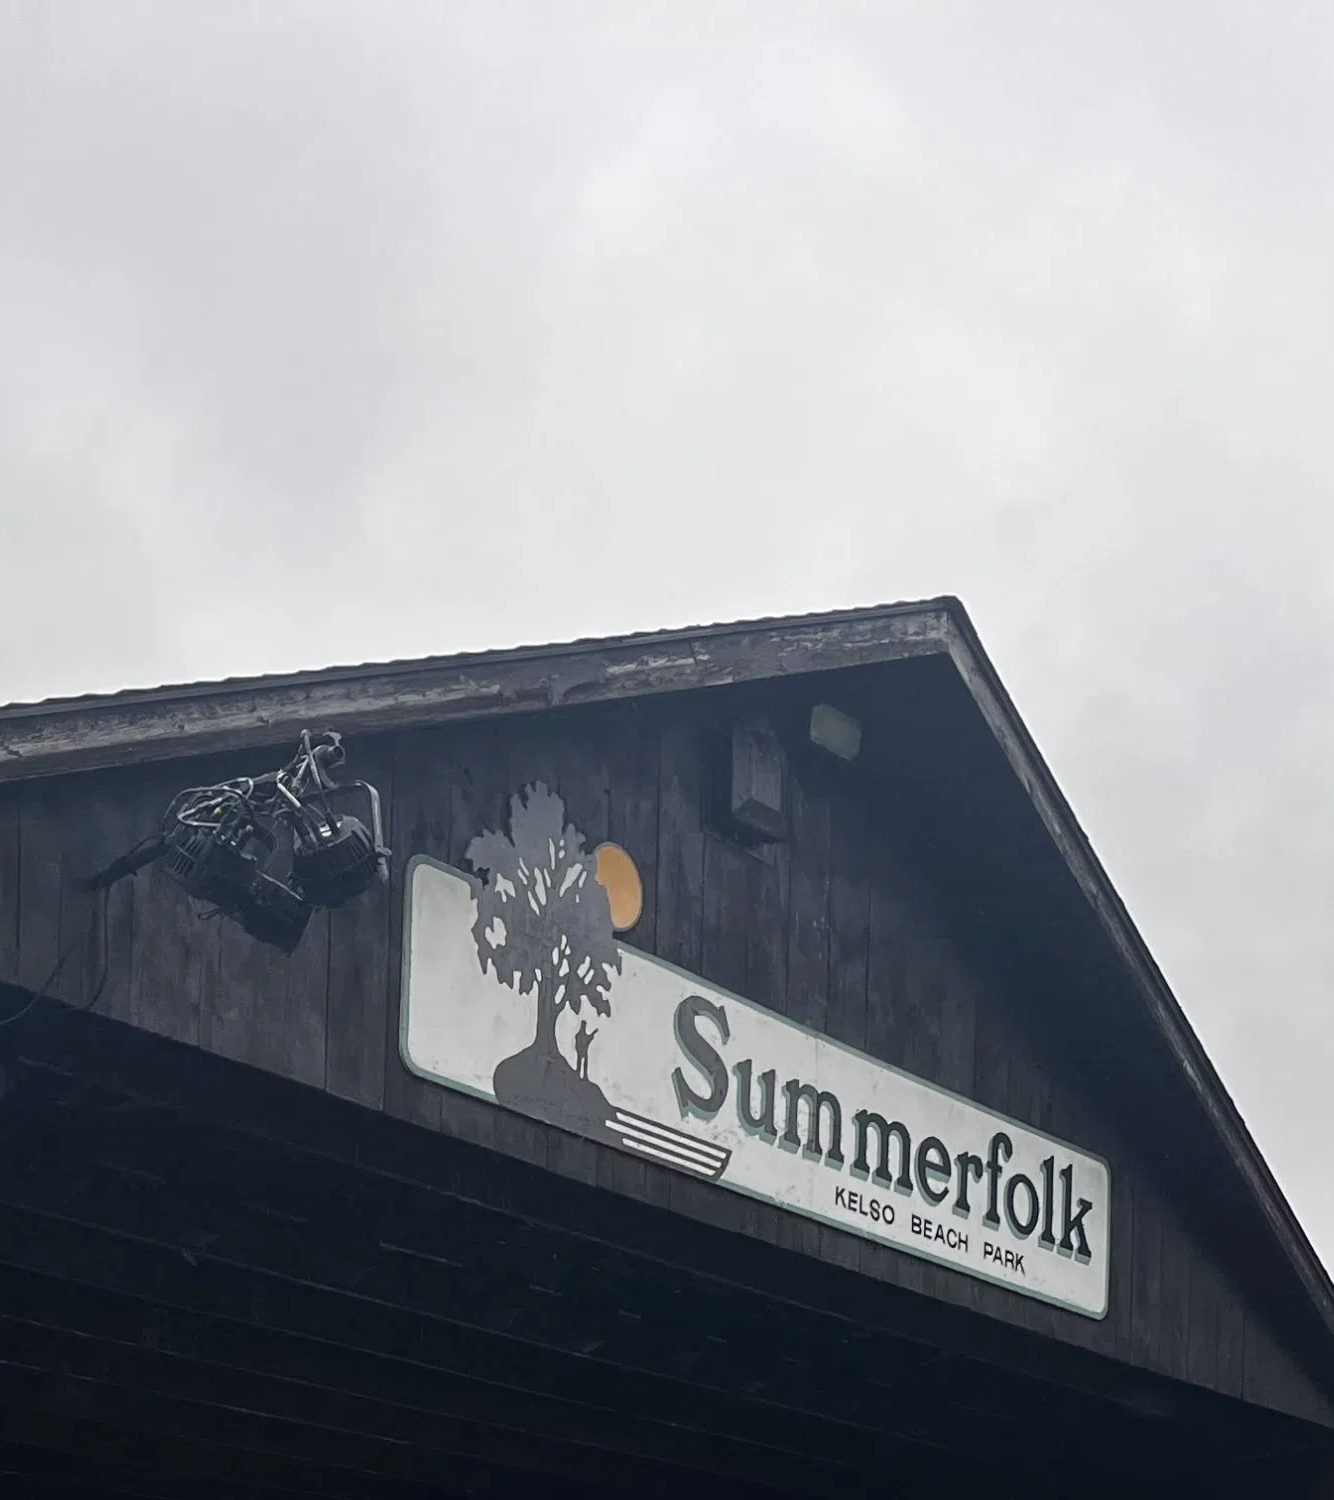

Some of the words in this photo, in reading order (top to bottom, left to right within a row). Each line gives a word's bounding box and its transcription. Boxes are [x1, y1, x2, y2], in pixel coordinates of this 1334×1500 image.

[672, 996, 1092, 1265] Summerfolk
[835, 1186, 895, 1225] KELSO
[911, 1214, 968, 1252] BEACH
[983, 1242, 1026, 1276] PARK
